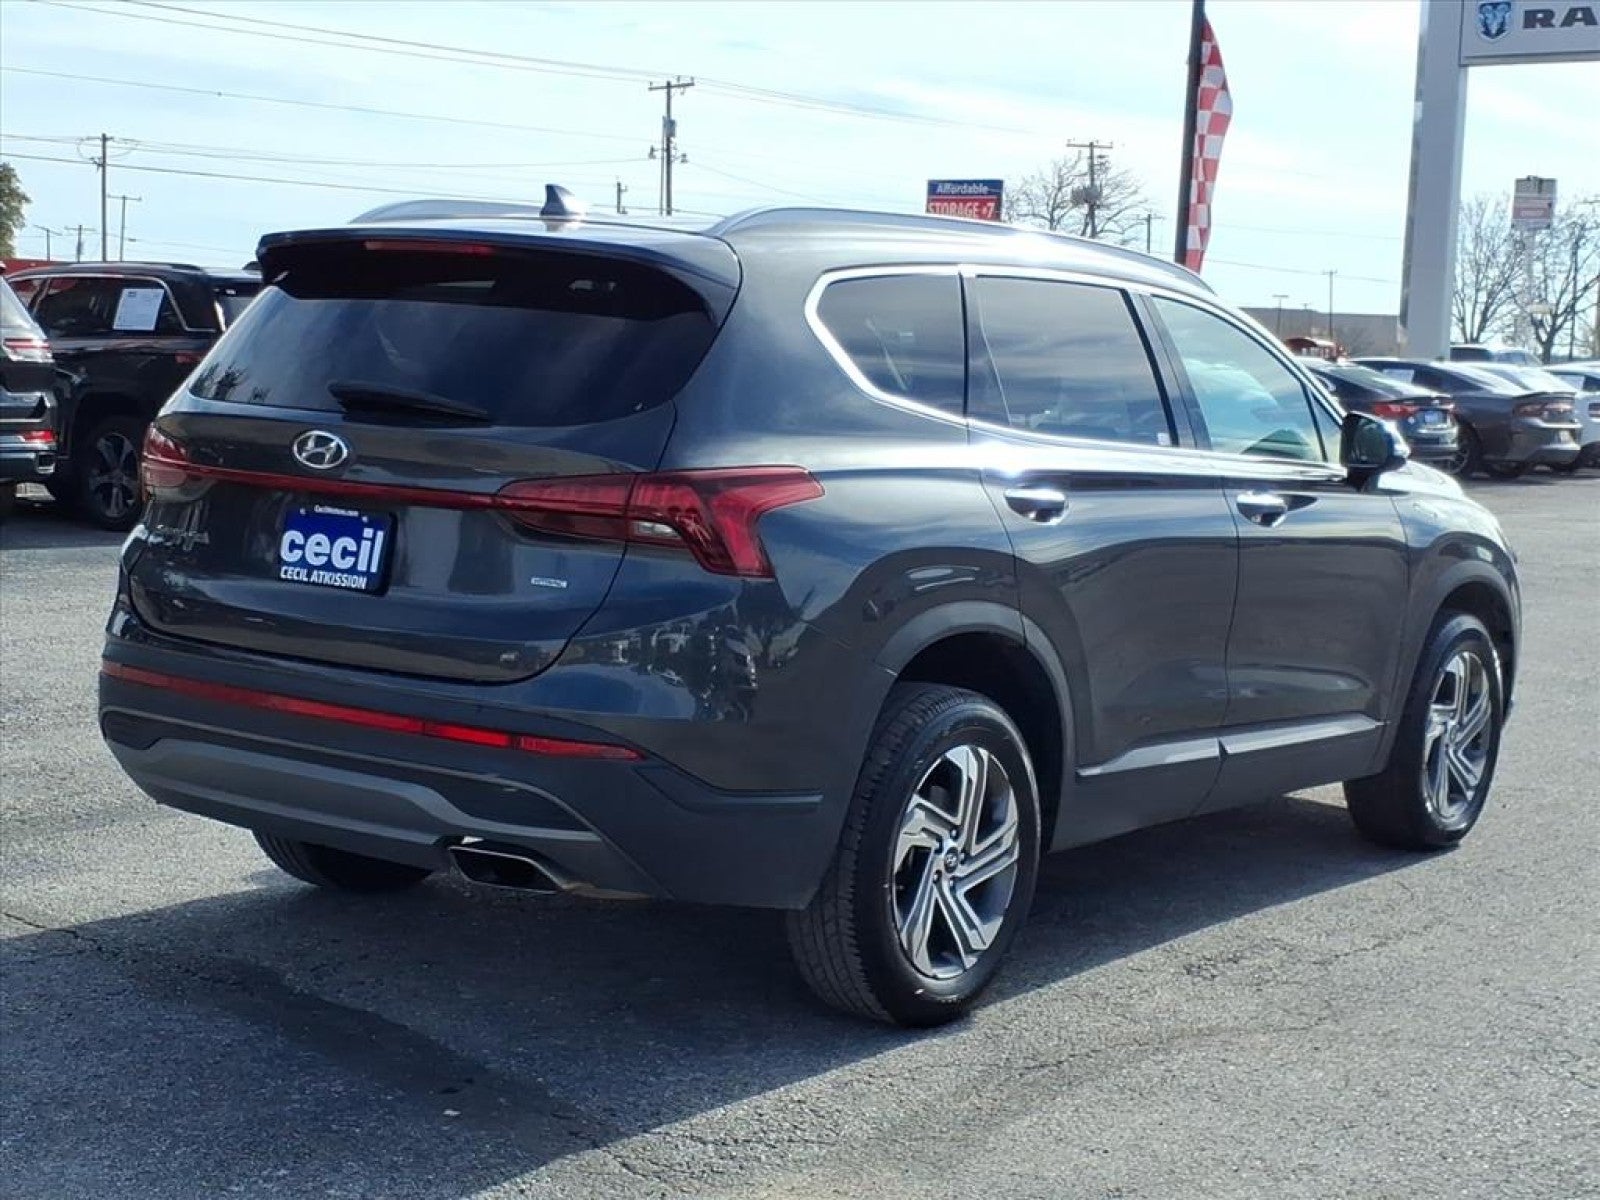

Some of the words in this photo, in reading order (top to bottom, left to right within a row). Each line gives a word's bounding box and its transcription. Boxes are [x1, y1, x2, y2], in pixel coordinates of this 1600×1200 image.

[928, 202, 979, 217] STORAGE
[281, 528, 384, 573] cecil
[281, 566, 309, 581] CECIL
[310, 569, 368, 589] ATKISSION
